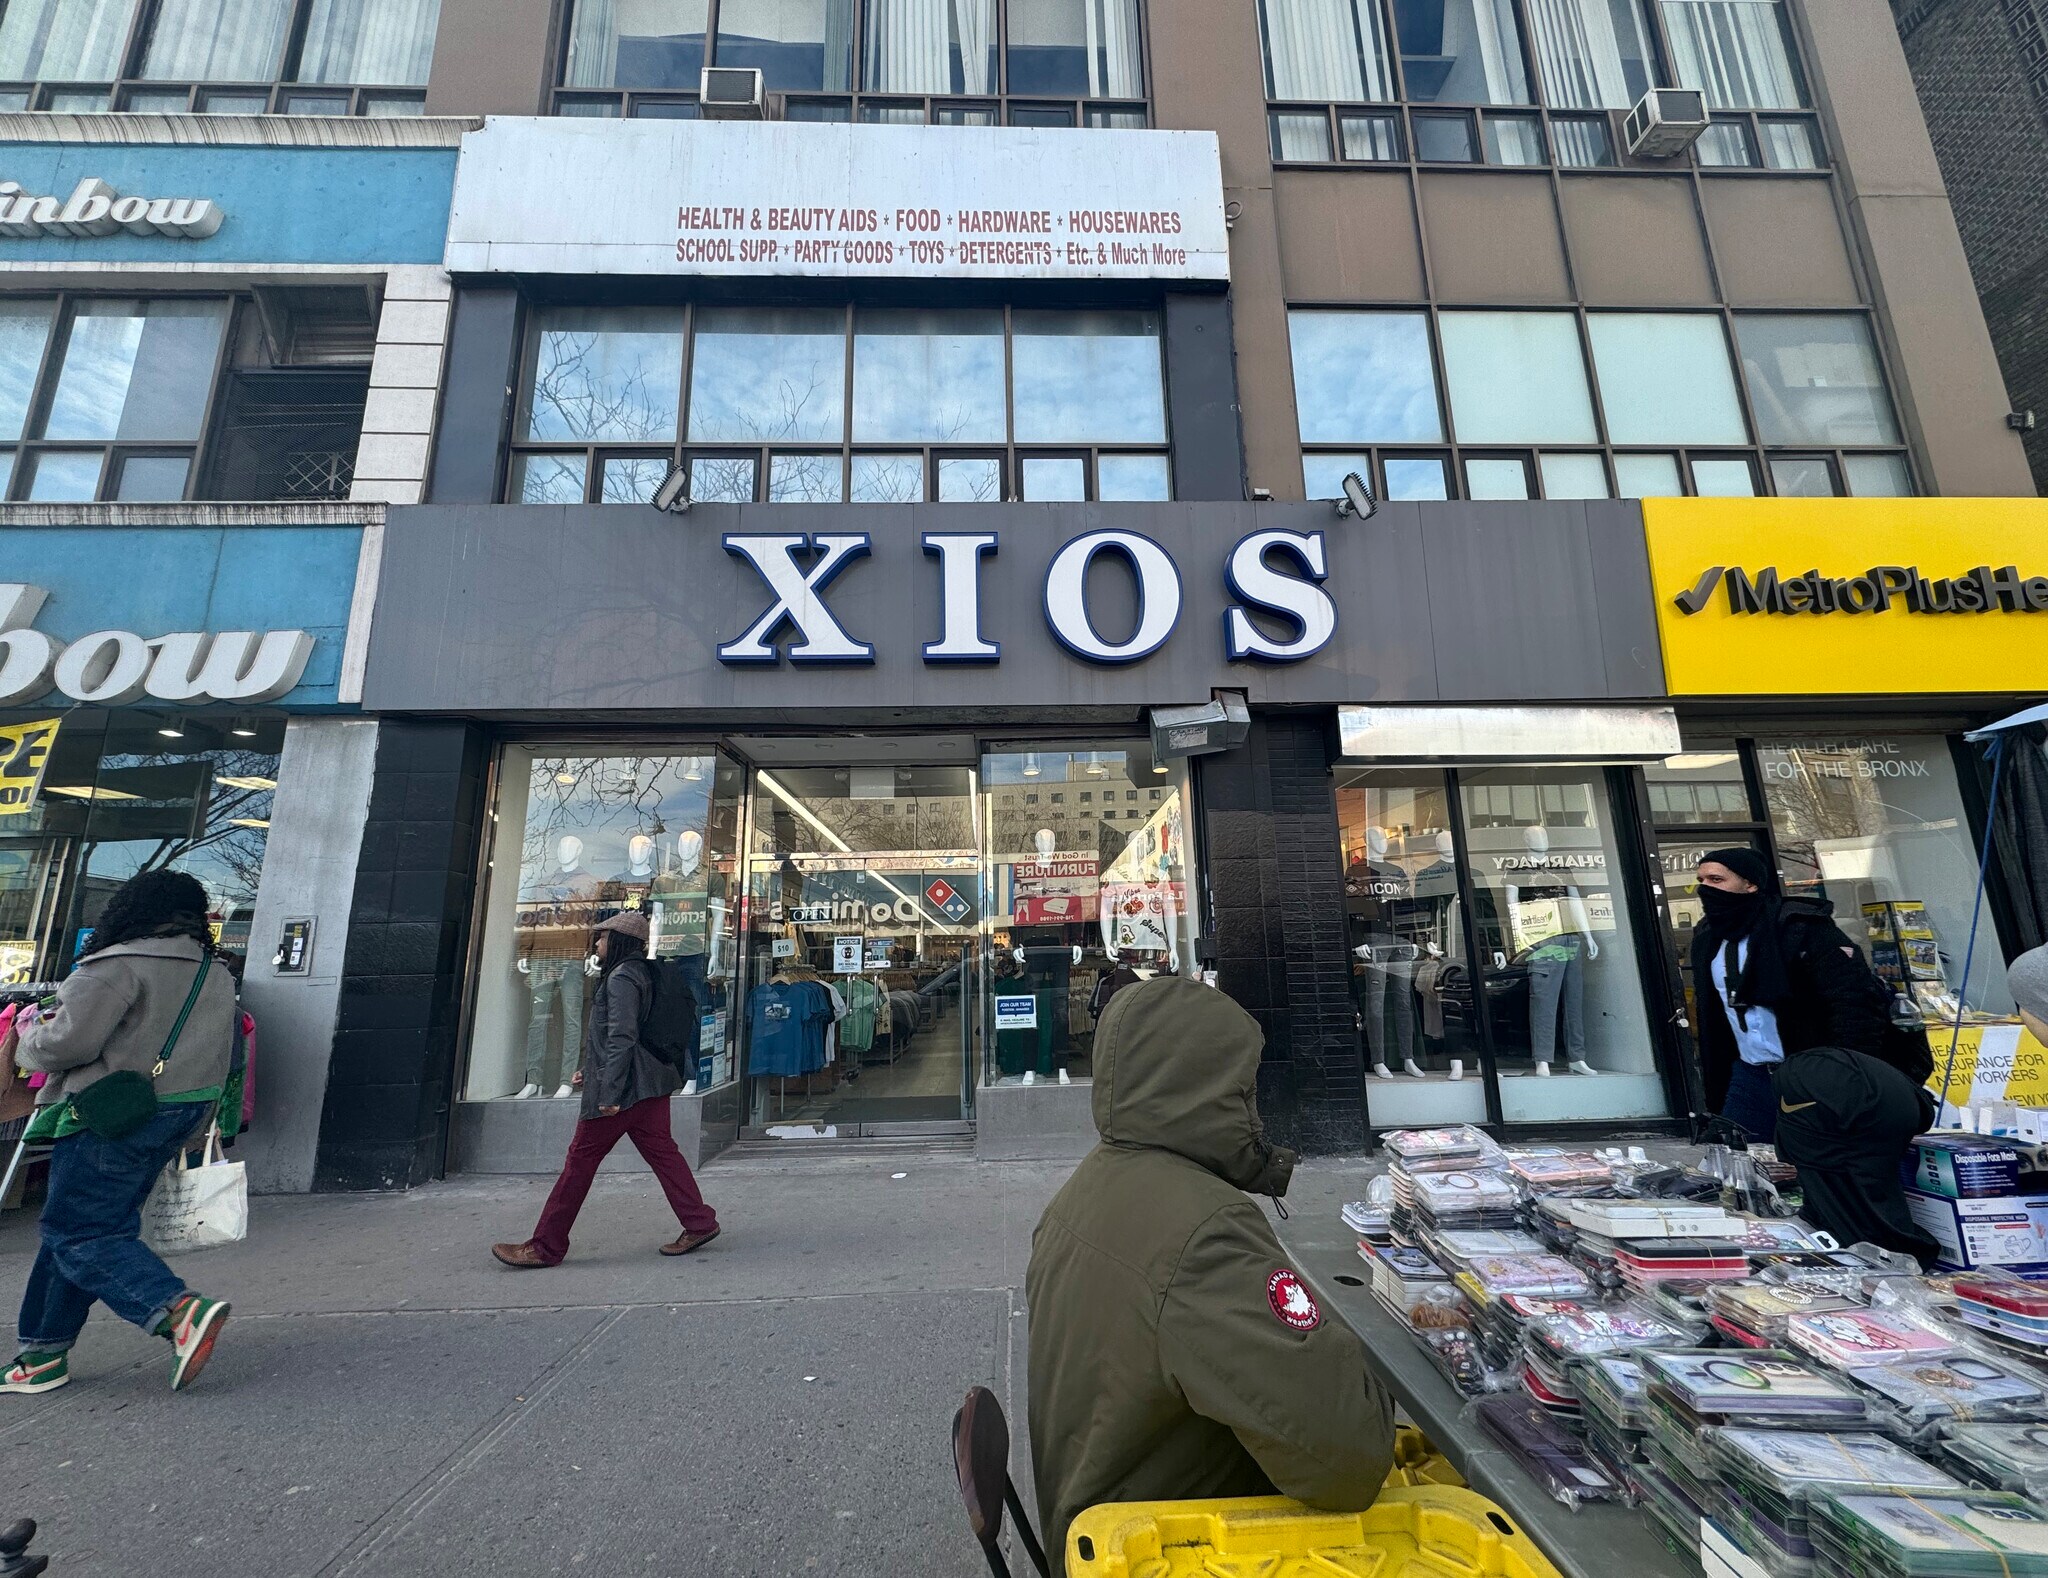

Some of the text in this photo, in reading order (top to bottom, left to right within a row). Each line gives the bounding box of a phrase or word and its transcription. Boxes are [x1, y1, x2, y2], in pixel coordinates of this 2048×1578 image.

[677, 207, 1182, 234] HEALTH & BEAUTY AIDS FOOD HARDWARE HOUSEWARES
[676, 238, 1186, 266] SCHOOL SUPP. PARTY GOODS TOYS DETERGENTS Etc. & Much More
[716, 528, 1338, 666] XIOS
[1762, 738, 1900, 756] HEALTH CARE
[1765, 760, 1930, 779] FOR THE BRONX
[793, 909, 830, 921] OPEN
[777, 944, 790, 953] $10
[2016, 1053, 2046, 1067] FOR
[1935, 1068, 2039, 1087] NEW YORKERS
[1954, 1151, 2018, 1165] Disposable Face Mask
